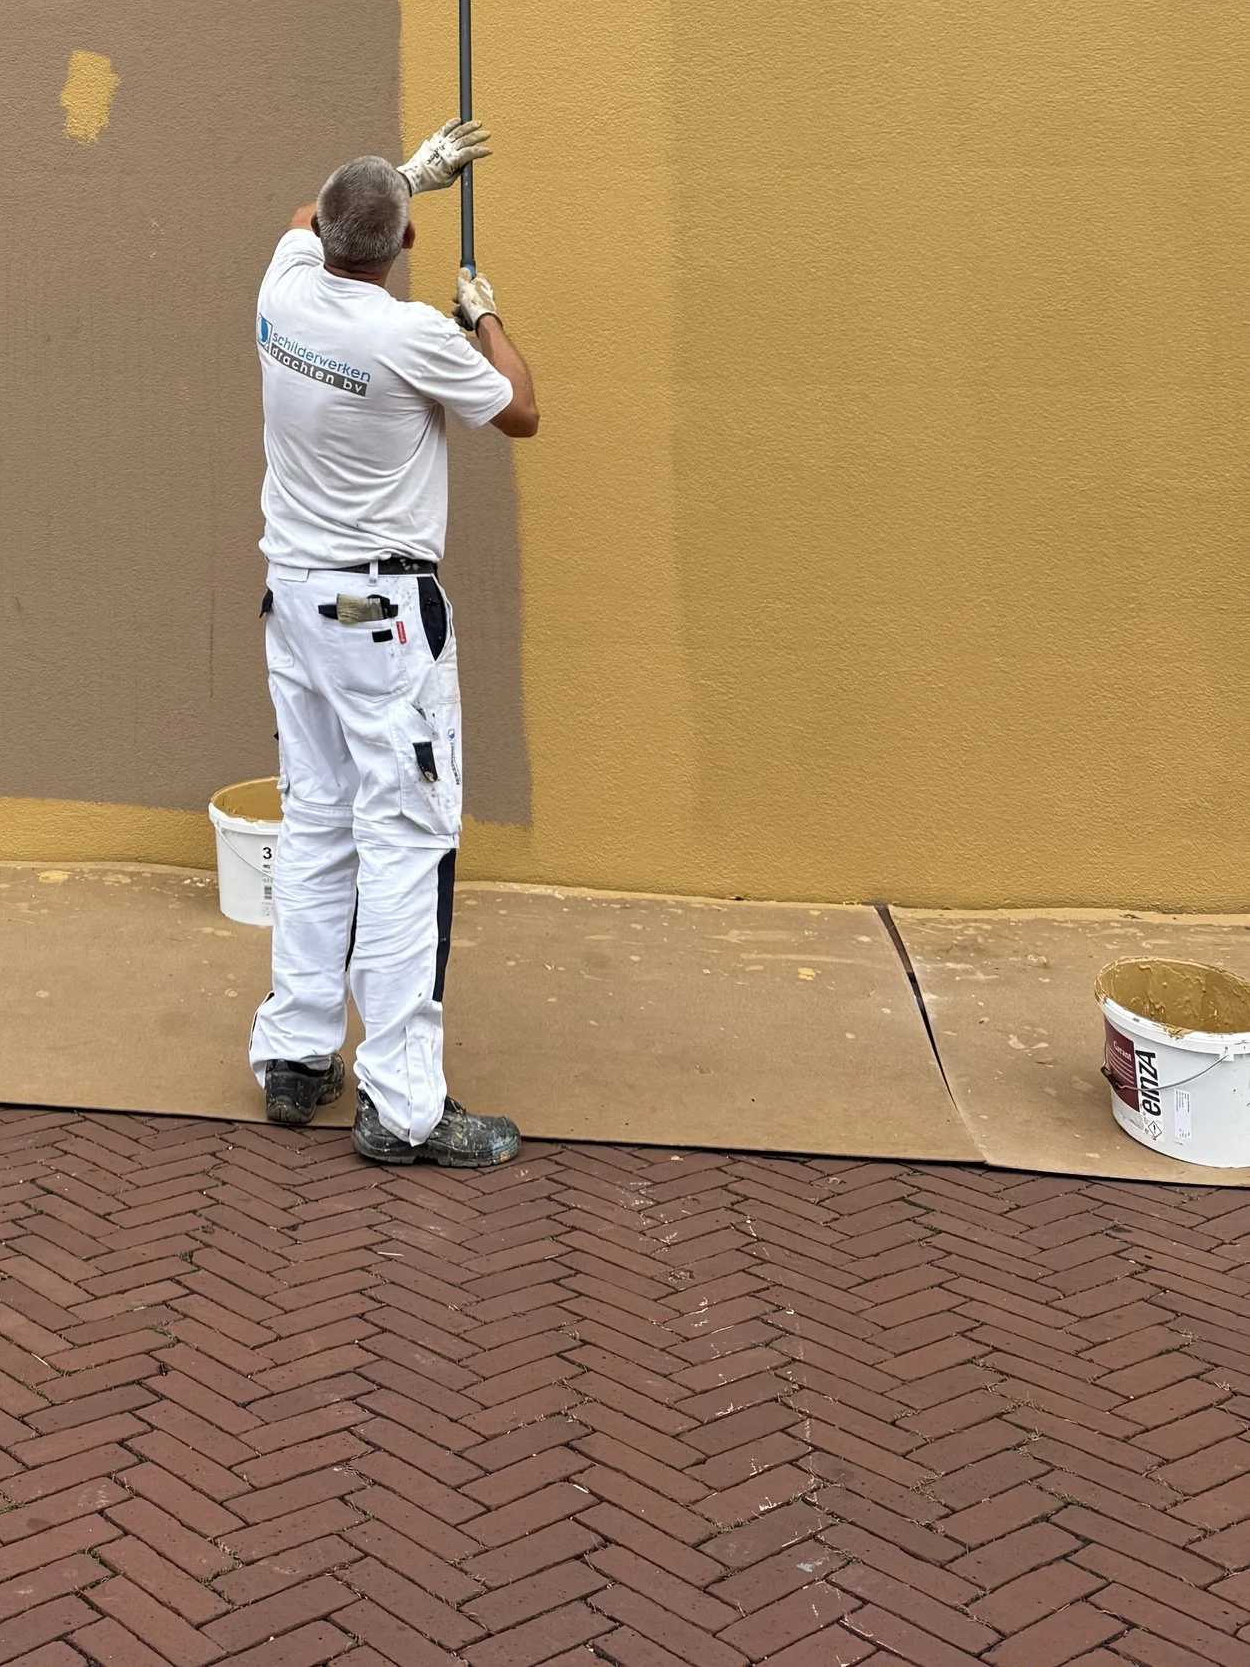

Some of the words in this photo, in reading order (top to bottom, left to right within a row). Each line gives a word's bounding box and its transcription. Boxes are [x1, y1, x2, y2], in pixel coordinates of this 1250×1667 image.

[271, 347, 335, 384] drachten
[343, 378, 363, 393] bv
[272, 333, 371, 382] schilderwerken
[262, 846, 272, 860] 3
